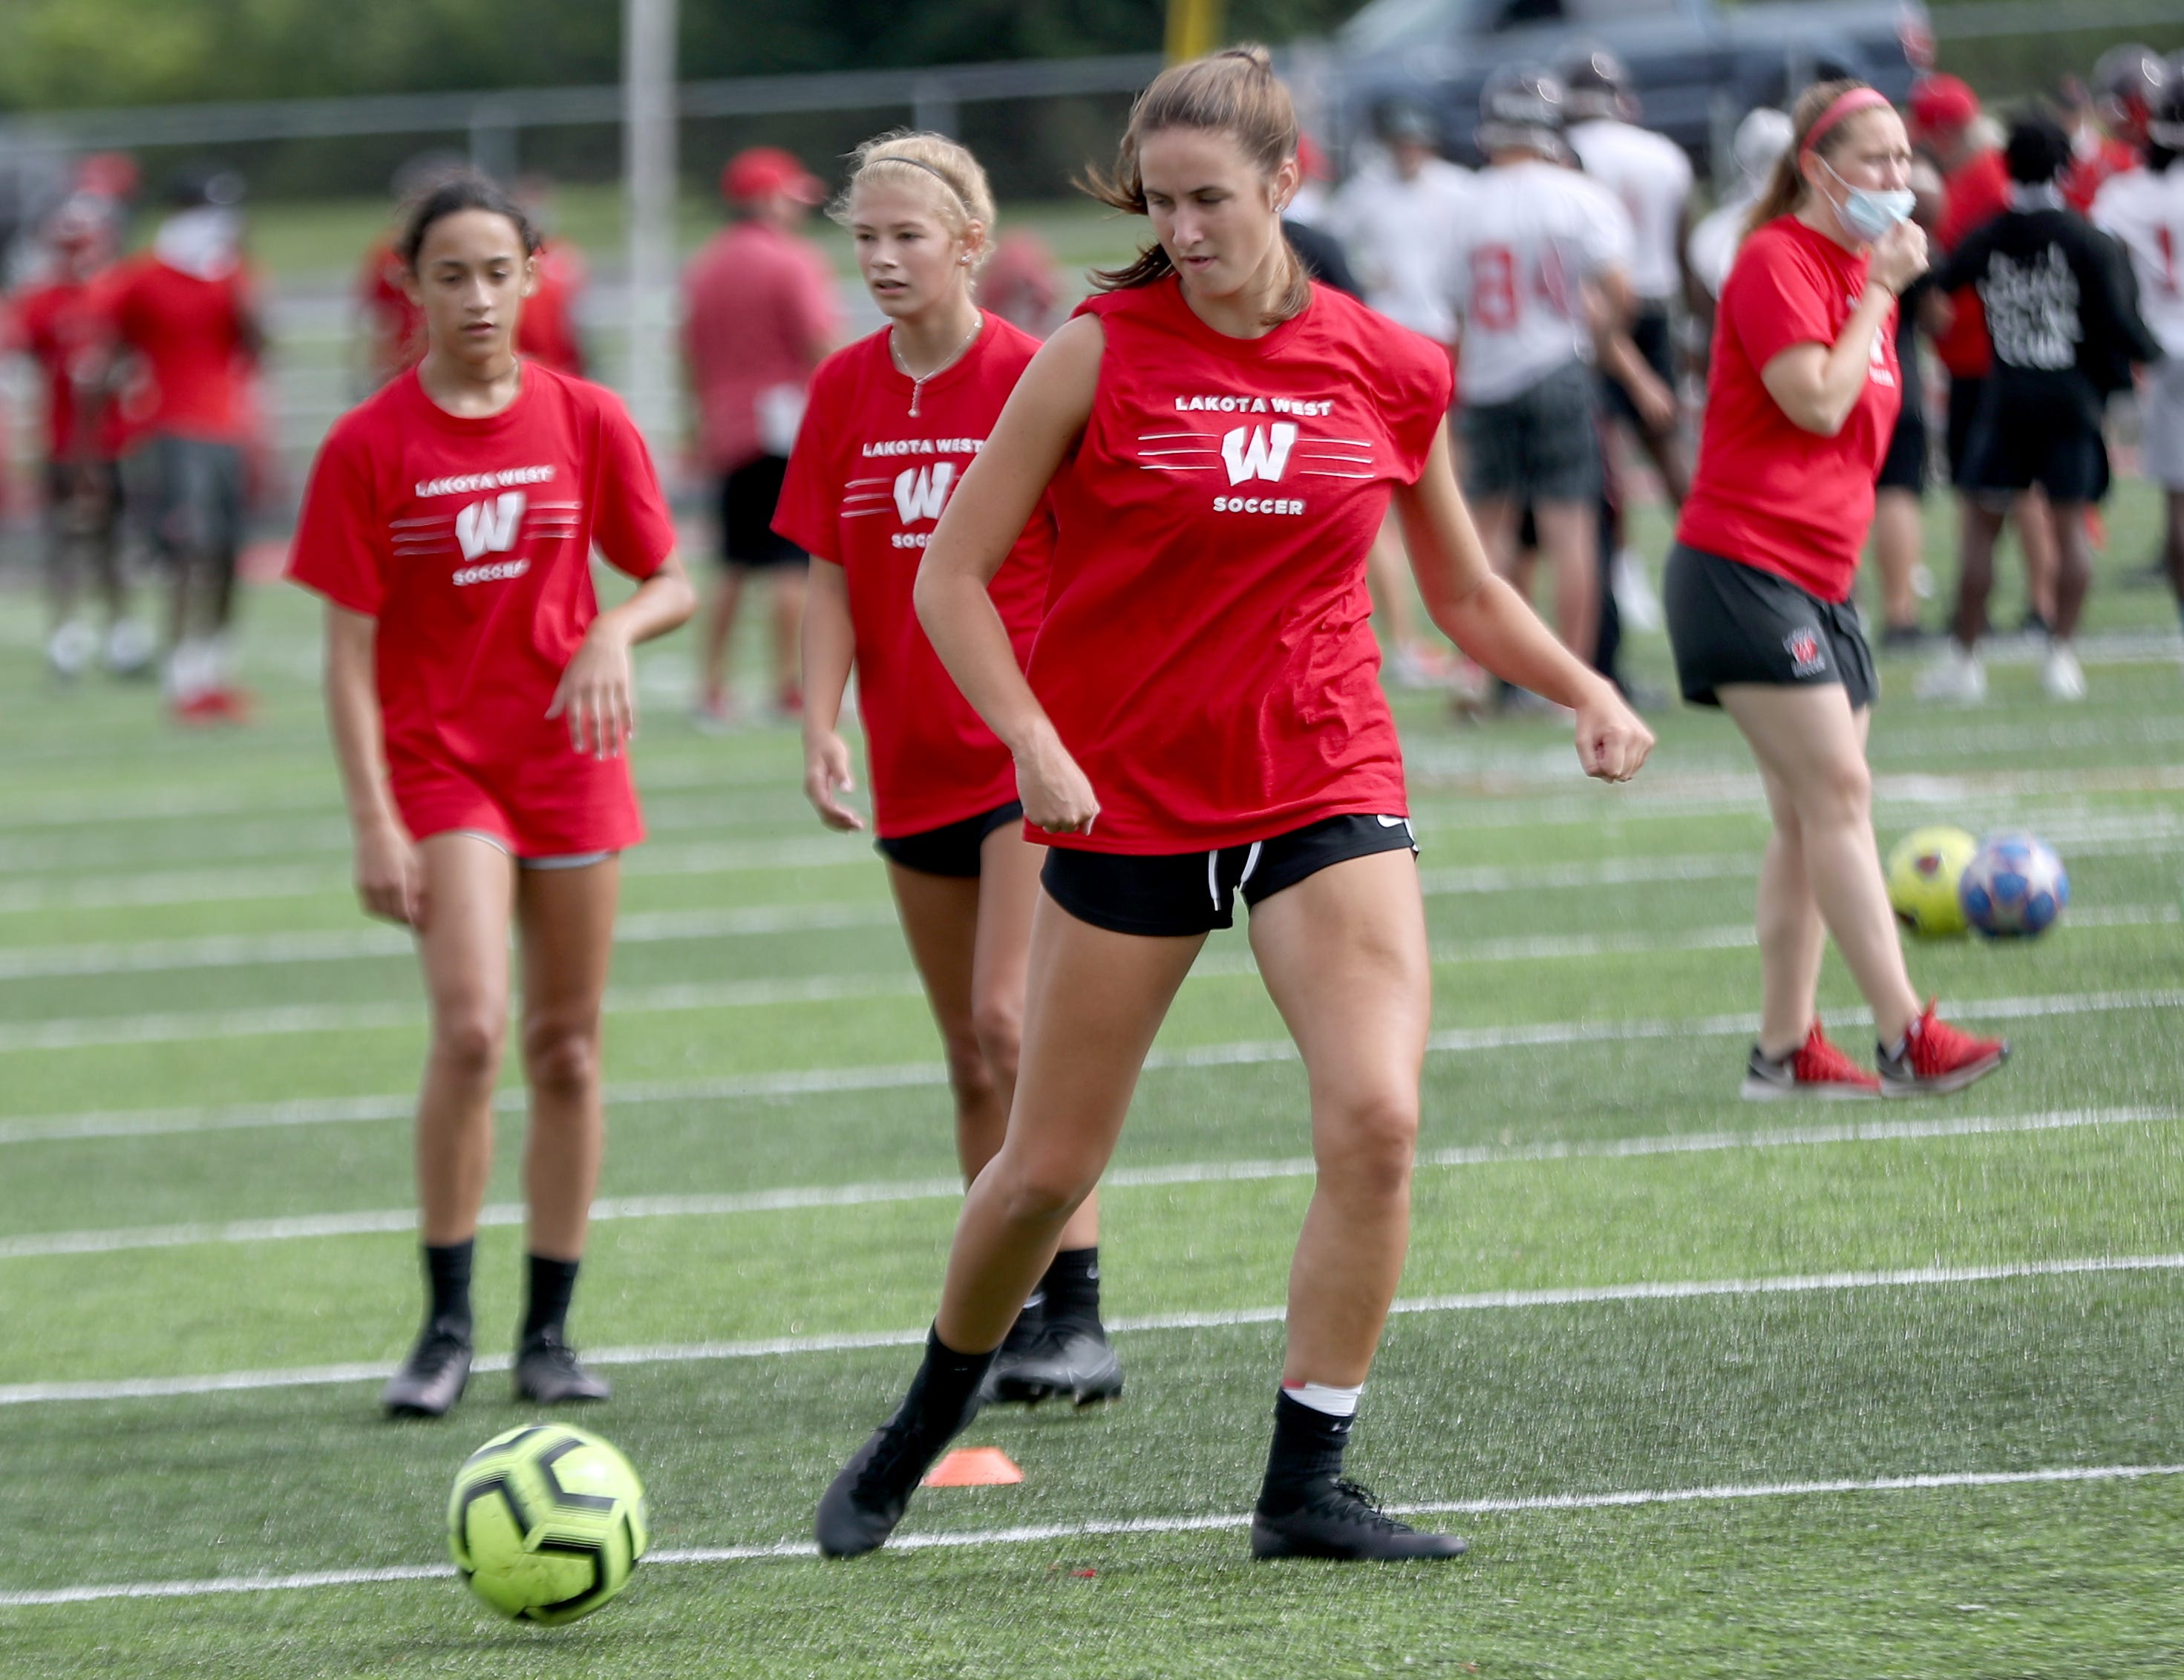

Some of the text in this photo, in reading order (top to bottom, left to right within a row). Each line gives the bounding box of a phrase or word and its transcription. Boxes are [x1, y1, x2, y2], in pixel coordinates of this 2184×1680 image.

[1175, 396, 1332, 416] LAKOTA WEST
[863, 438, 985, 457] LAKOTA WEST
[1221, 422, 1296, 486] W
[415, 465, 555, 497] LAKOTA WEST
[893, 461, 956, 525] W
[1213, 497, 1304, 515] SOCCER
[455, 491, 526, 561] W
[452, 558, 530, 586] SOCCER
